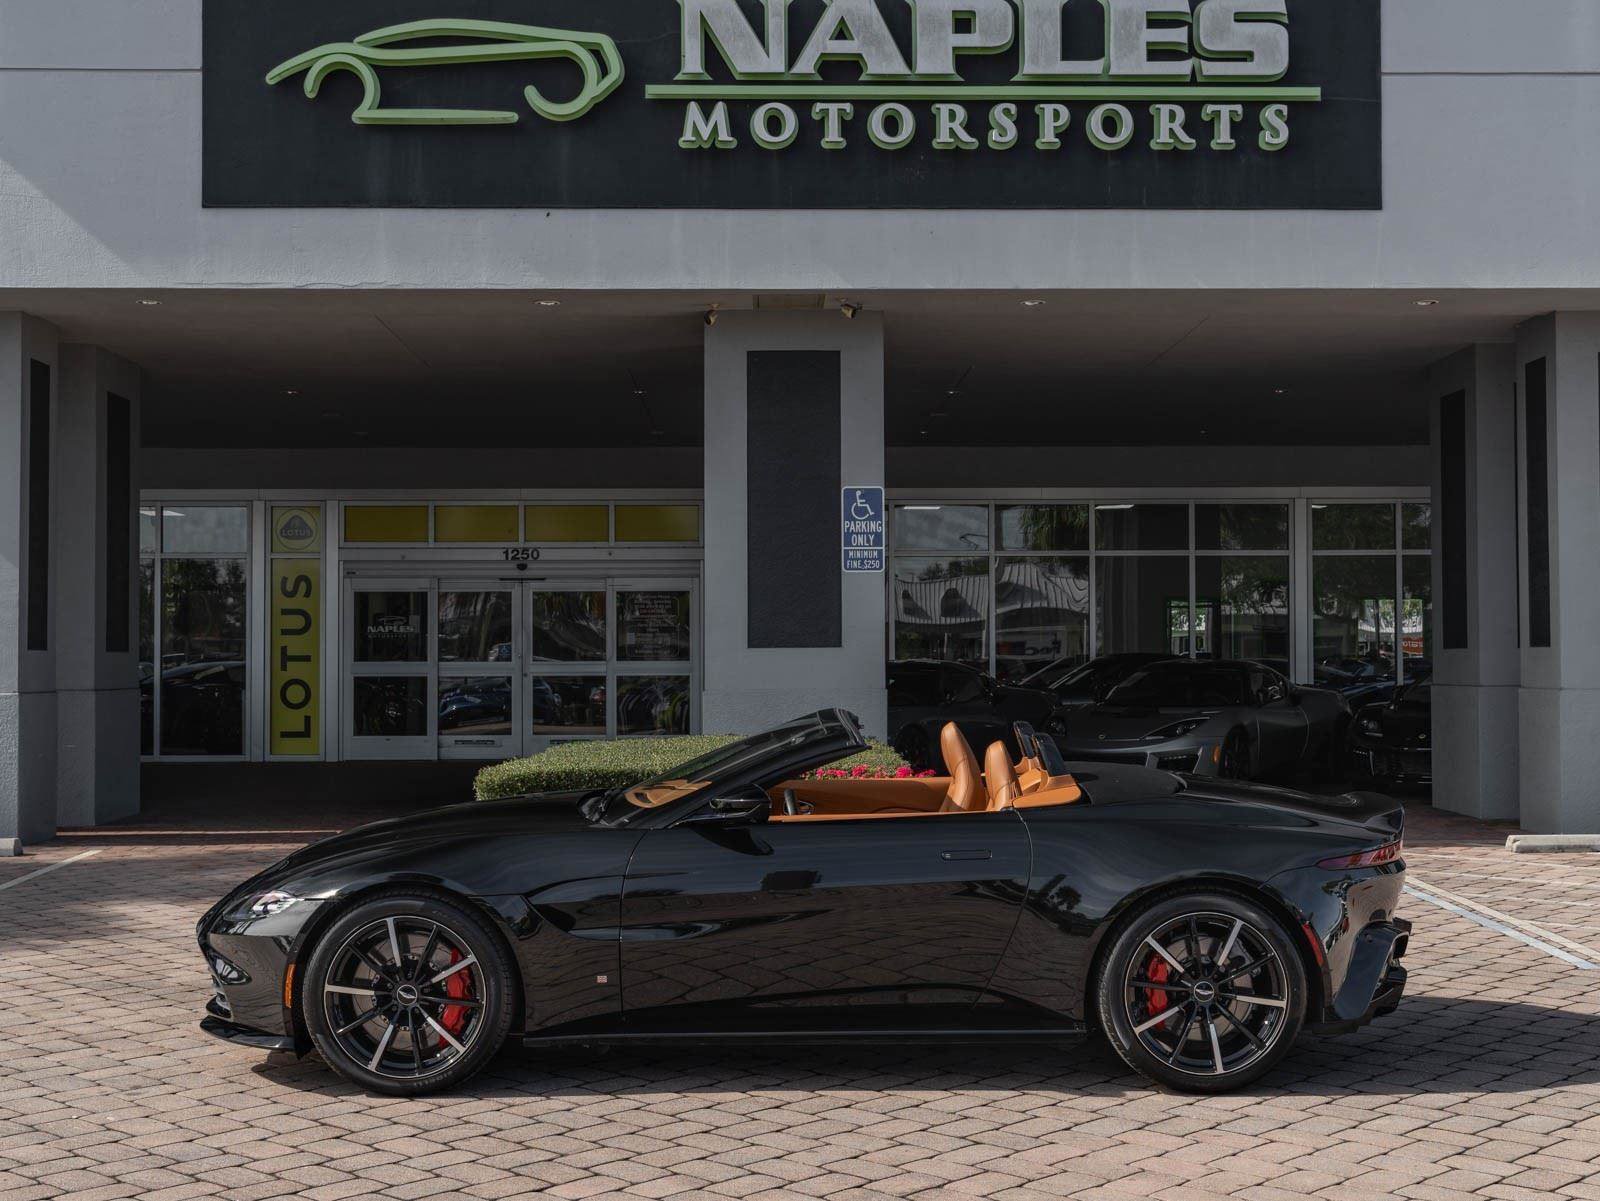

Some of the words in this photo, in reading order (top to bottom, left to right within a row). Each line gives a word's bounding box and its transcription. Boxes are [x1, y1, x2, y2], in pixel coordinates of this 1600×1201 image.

[674, 0, 1290, 82] NAPLES
[679, 101, 1290, 150] MOTORSPORTS
[844, 520, 882, 533] PARKING
[282, 529, 311, 537] LOTUS
[851, 534, 875, 546] ONLY
[503, 548, 540, 560] 1250
[848, 550, 878, 559] MINIMUM
[846, 560, 861, 569] FINE
[863, 560, 880, 569] $250
[280, 574, 312, 738] LOTUS
